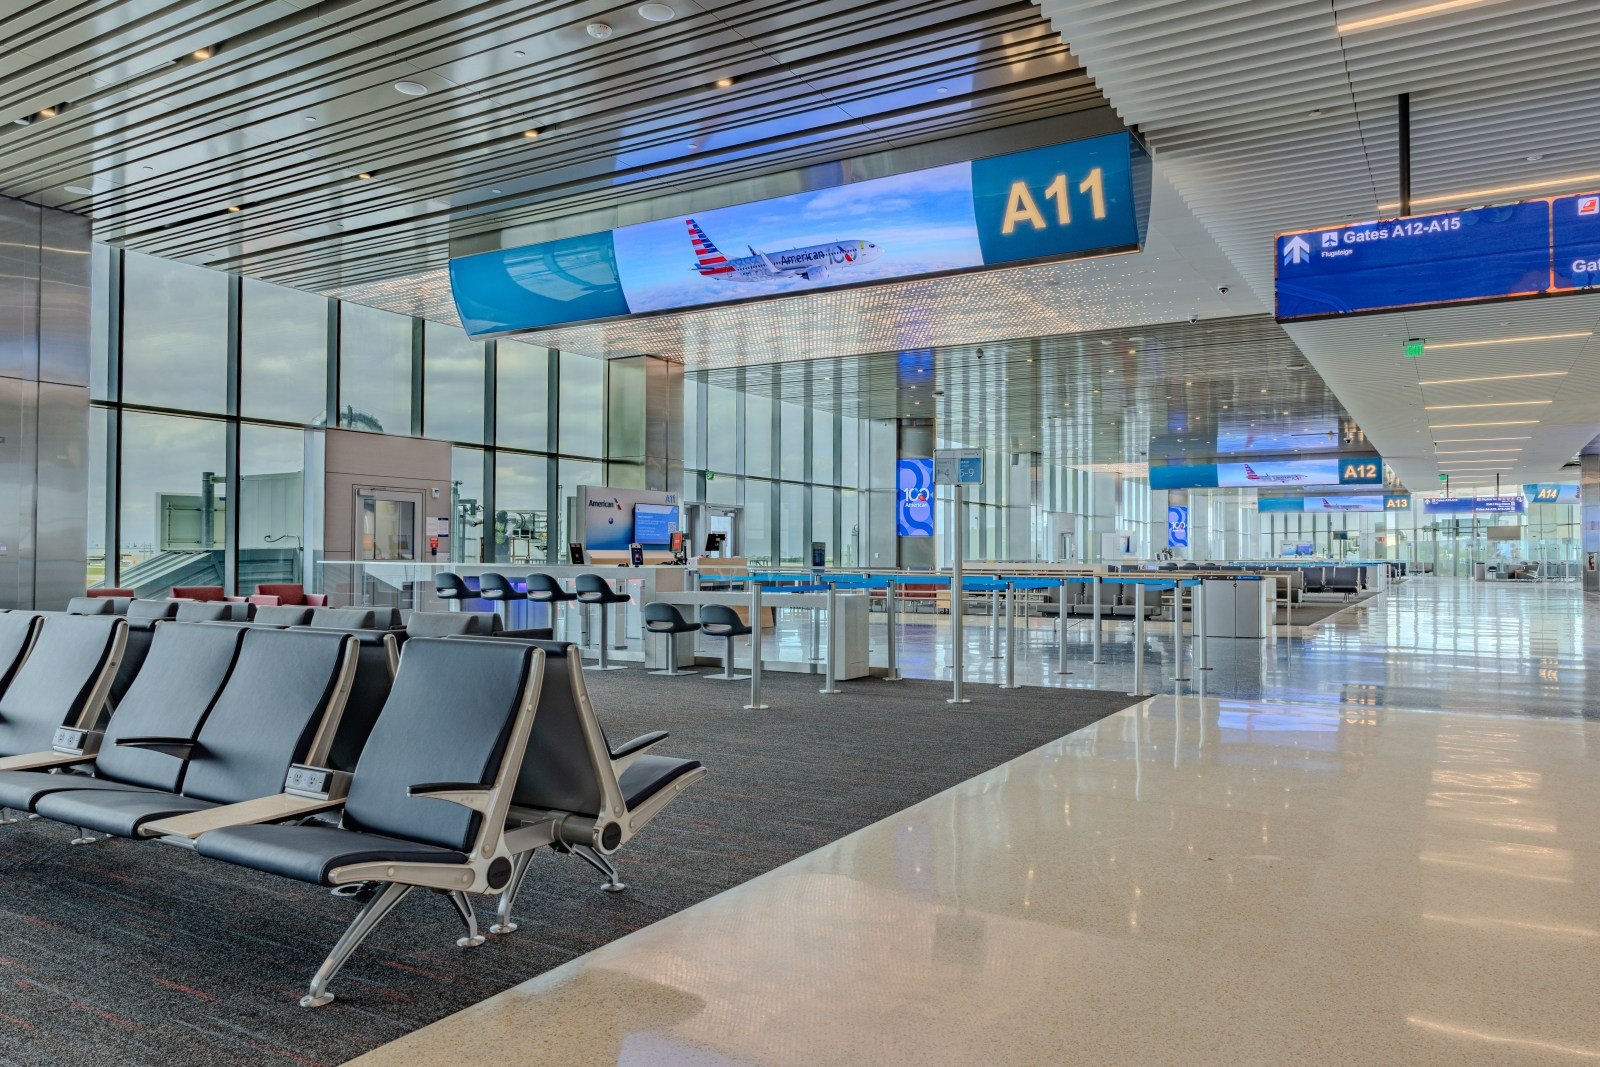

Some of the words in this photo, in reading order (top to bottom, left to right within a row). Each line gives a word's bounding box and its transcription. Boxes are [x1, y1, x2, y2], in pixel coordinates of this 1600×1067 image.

[1001, 167, 1107, 235] A11
[1343, 228, 1389, 244] Gates
[1392, 217, 1461, 238] A12-A15
[781, 250, 825, 266] American
[1321, 248, 1353, 258] Flugsteige
[1408, 344, 1422, 357] EXIT
[1343, 464, 1377, 479] A12
[665, 494, 676, 504] A11
[903, 487, 930, 502] 100
[1537, 488, 1557, 499] A14
[588, 499, 614, 509] American
[1386, 498, 1408, 508] A13
